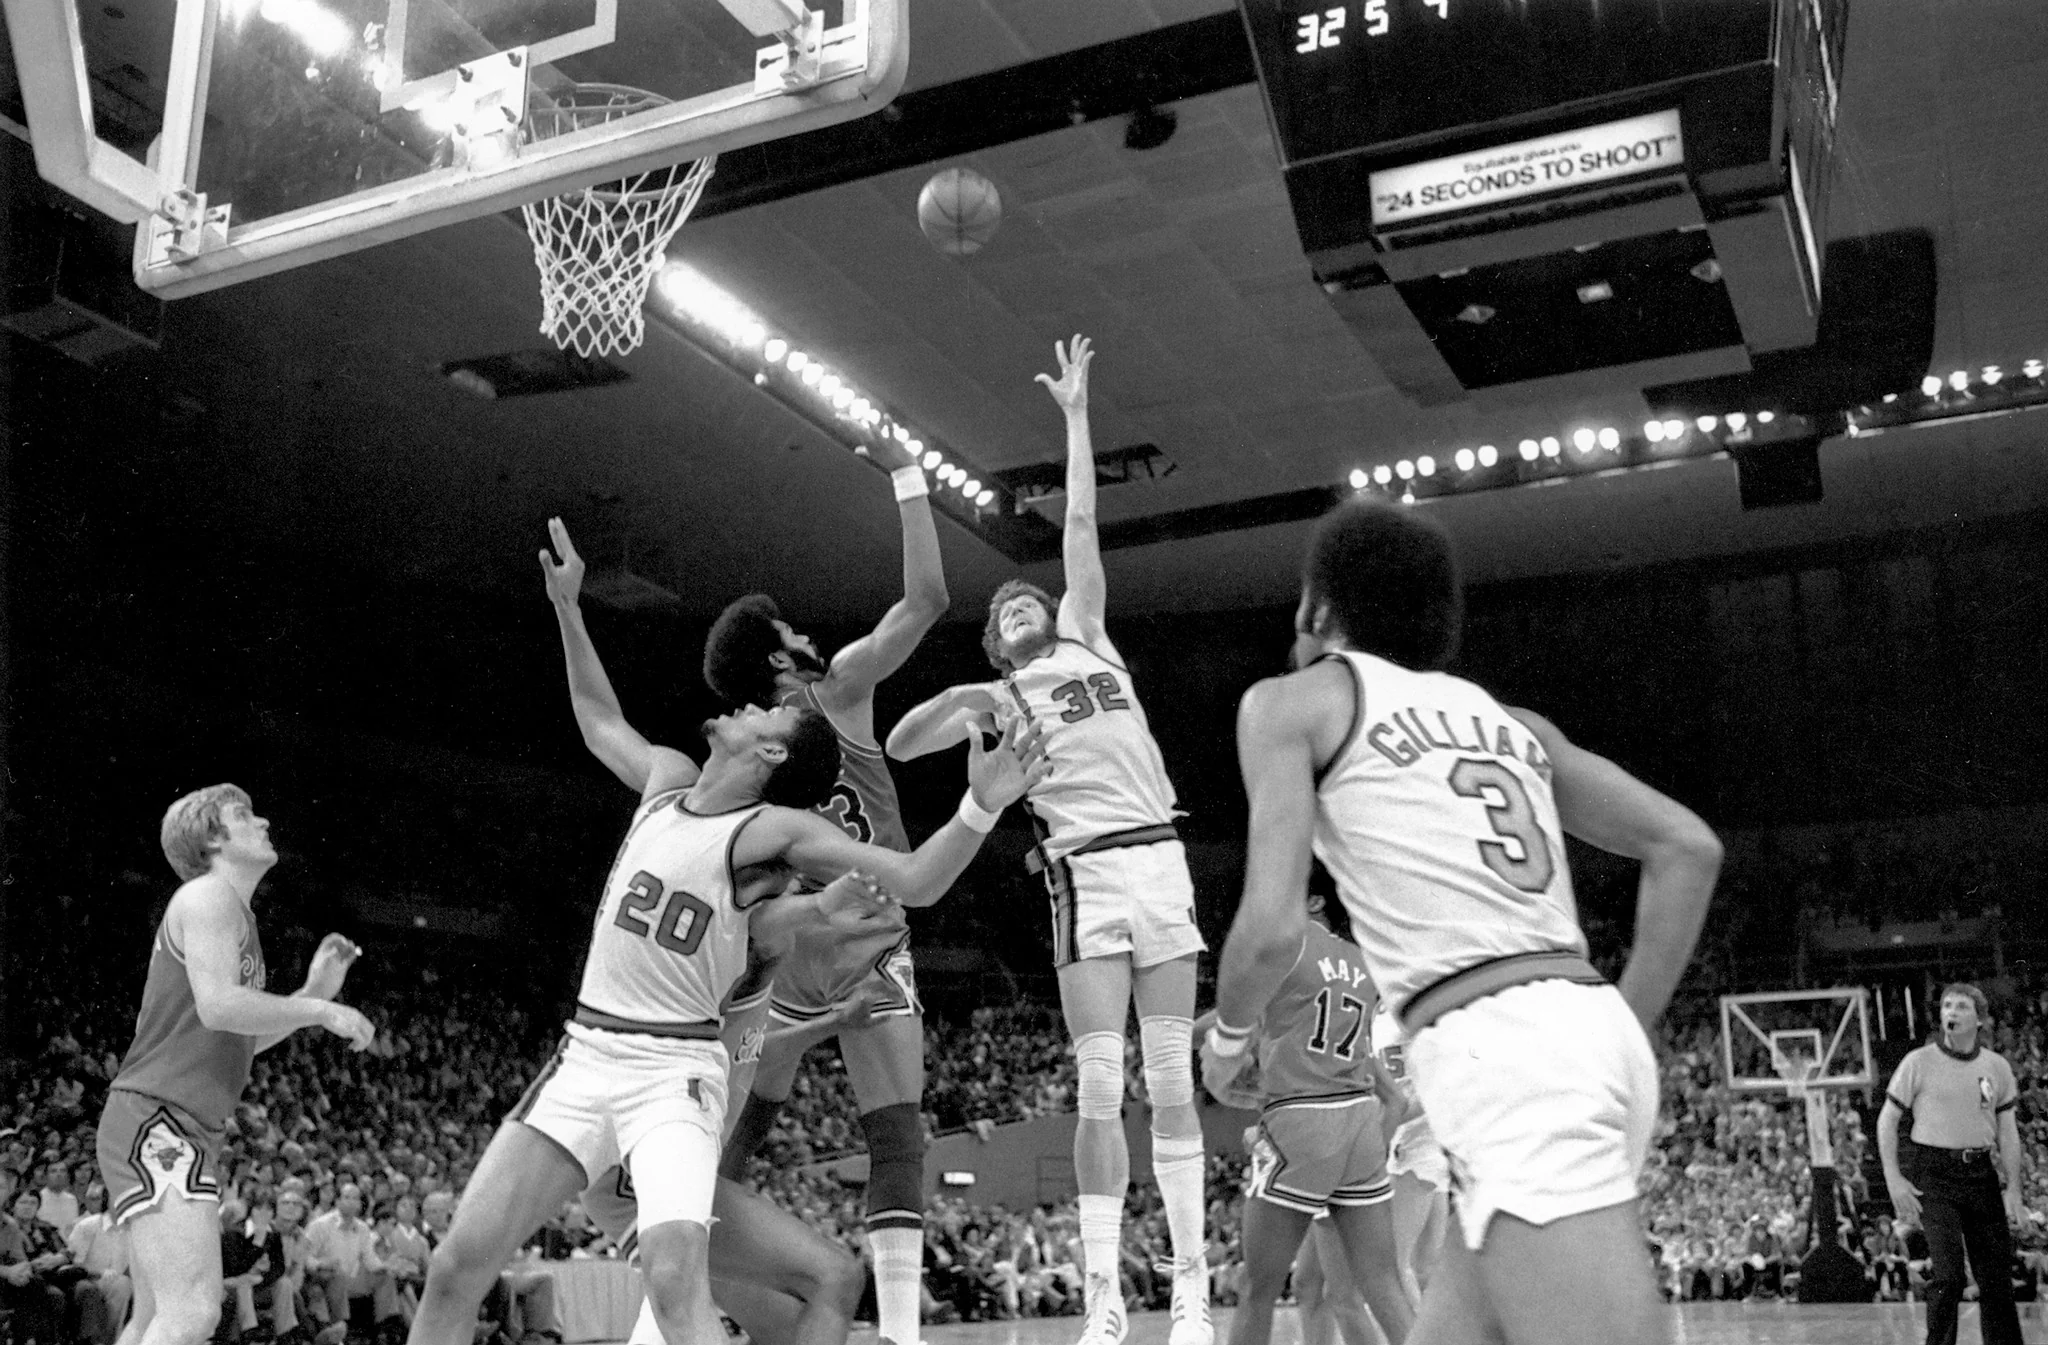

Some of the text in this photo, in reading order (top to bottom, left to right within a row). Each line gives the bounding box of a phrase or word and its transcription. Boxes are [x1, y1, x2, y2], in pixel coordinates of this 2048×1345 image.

[1296, 6, 1346, 54] 32
[1364, 0, 1389, 36] 5
[1420, 165, 1536, 206] SECONDS
[1541, 157, 1575, 181] TO
[1050, 671, 1131, 724] 32
[1446, 756, 1556, 895] 3
[613, 869, 714, 957] 20
[1317, 956, 1367, 988] MAY
[1306, 986, 1367, 1062] 17
